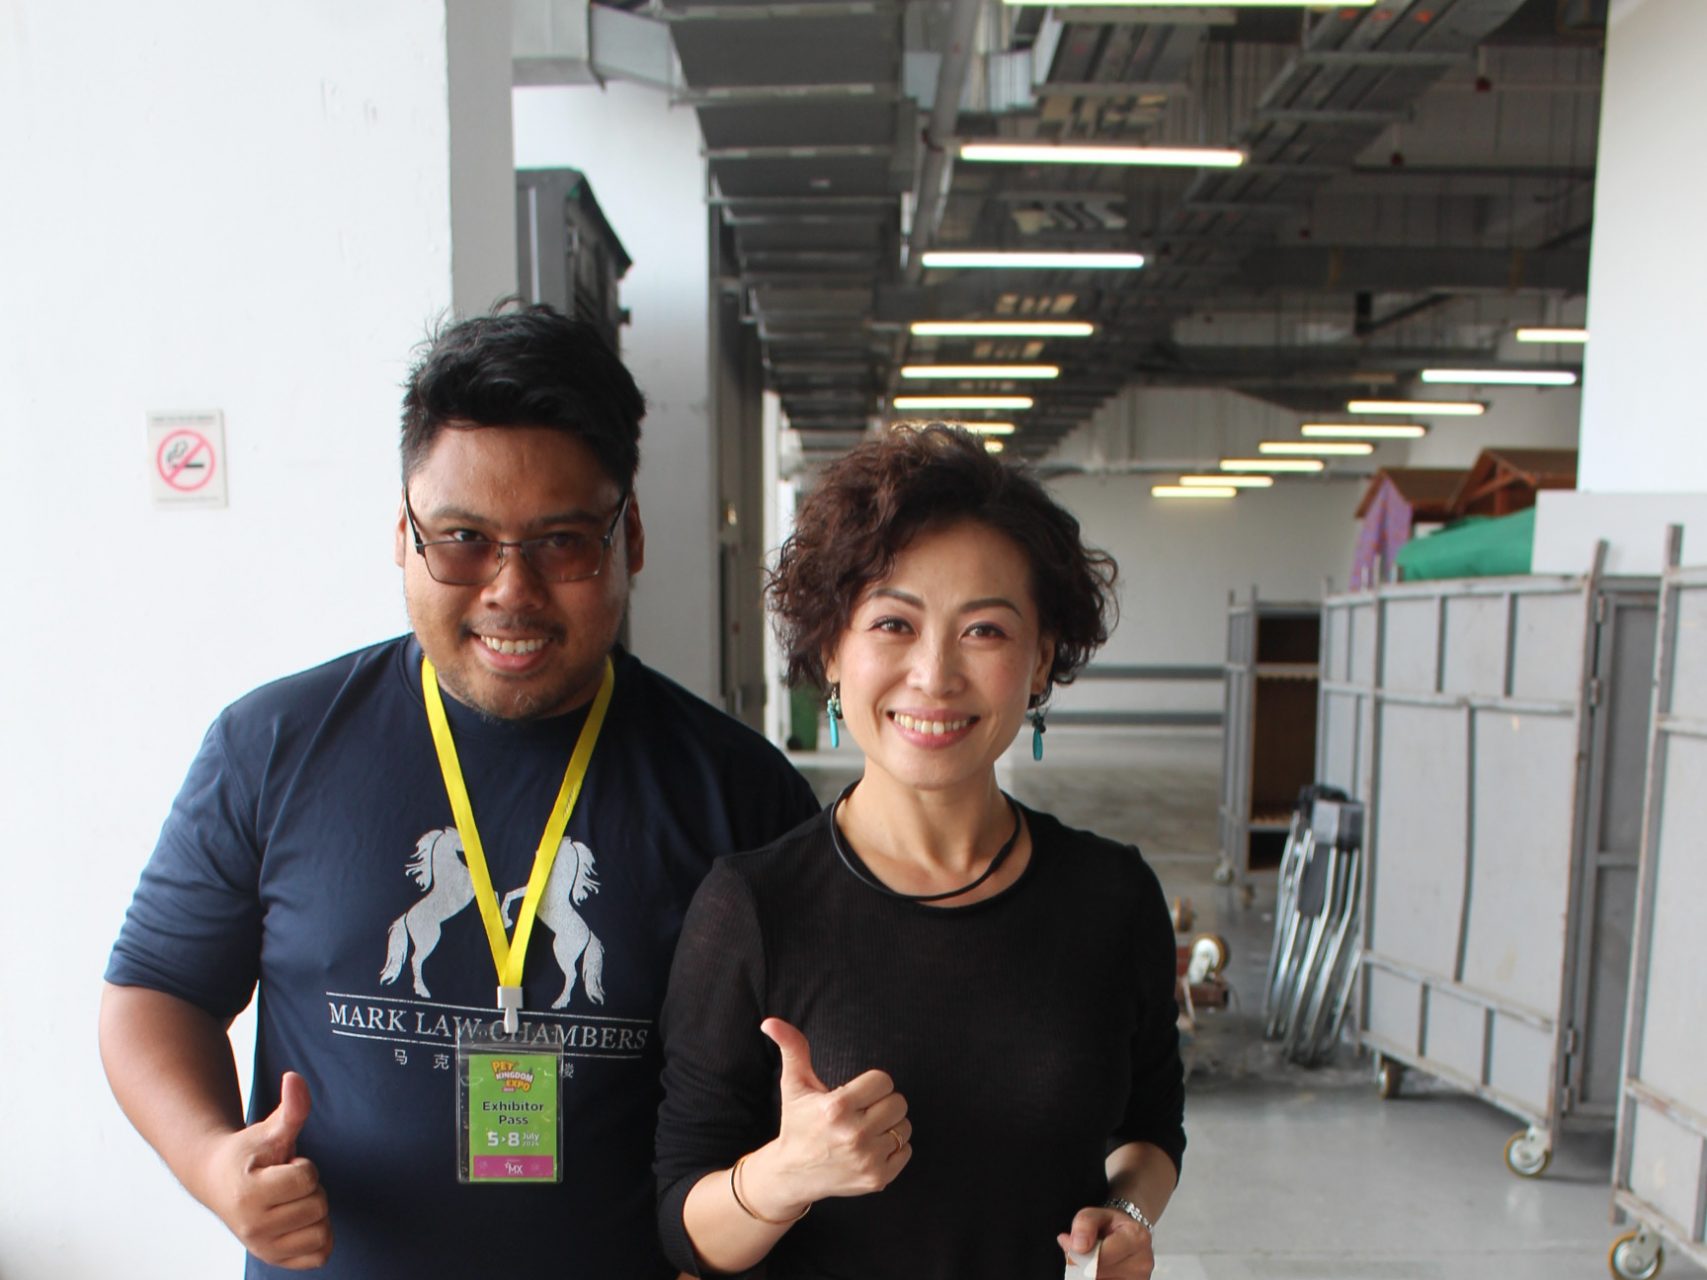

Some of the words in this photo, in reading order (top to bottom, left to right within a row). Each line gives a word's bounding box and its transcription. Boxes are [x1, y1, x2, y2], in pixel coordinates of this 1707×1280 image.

[329, 1002, 407, 1032] MARK
[415, 1011, 482, 1041] LAW
[490, 1020, 648, 1050] CHAMBERS
[491, 1060, 513, 1073] PET
[495, 1071, 534, 1083] KINGDOM
[506, 1079, 531, 1091] EXPO
[482, 1100, 544, 1111] Exhibitor
[499, 1115, 529, 1125] Pass
[522, 1132, 540, 1142] July
